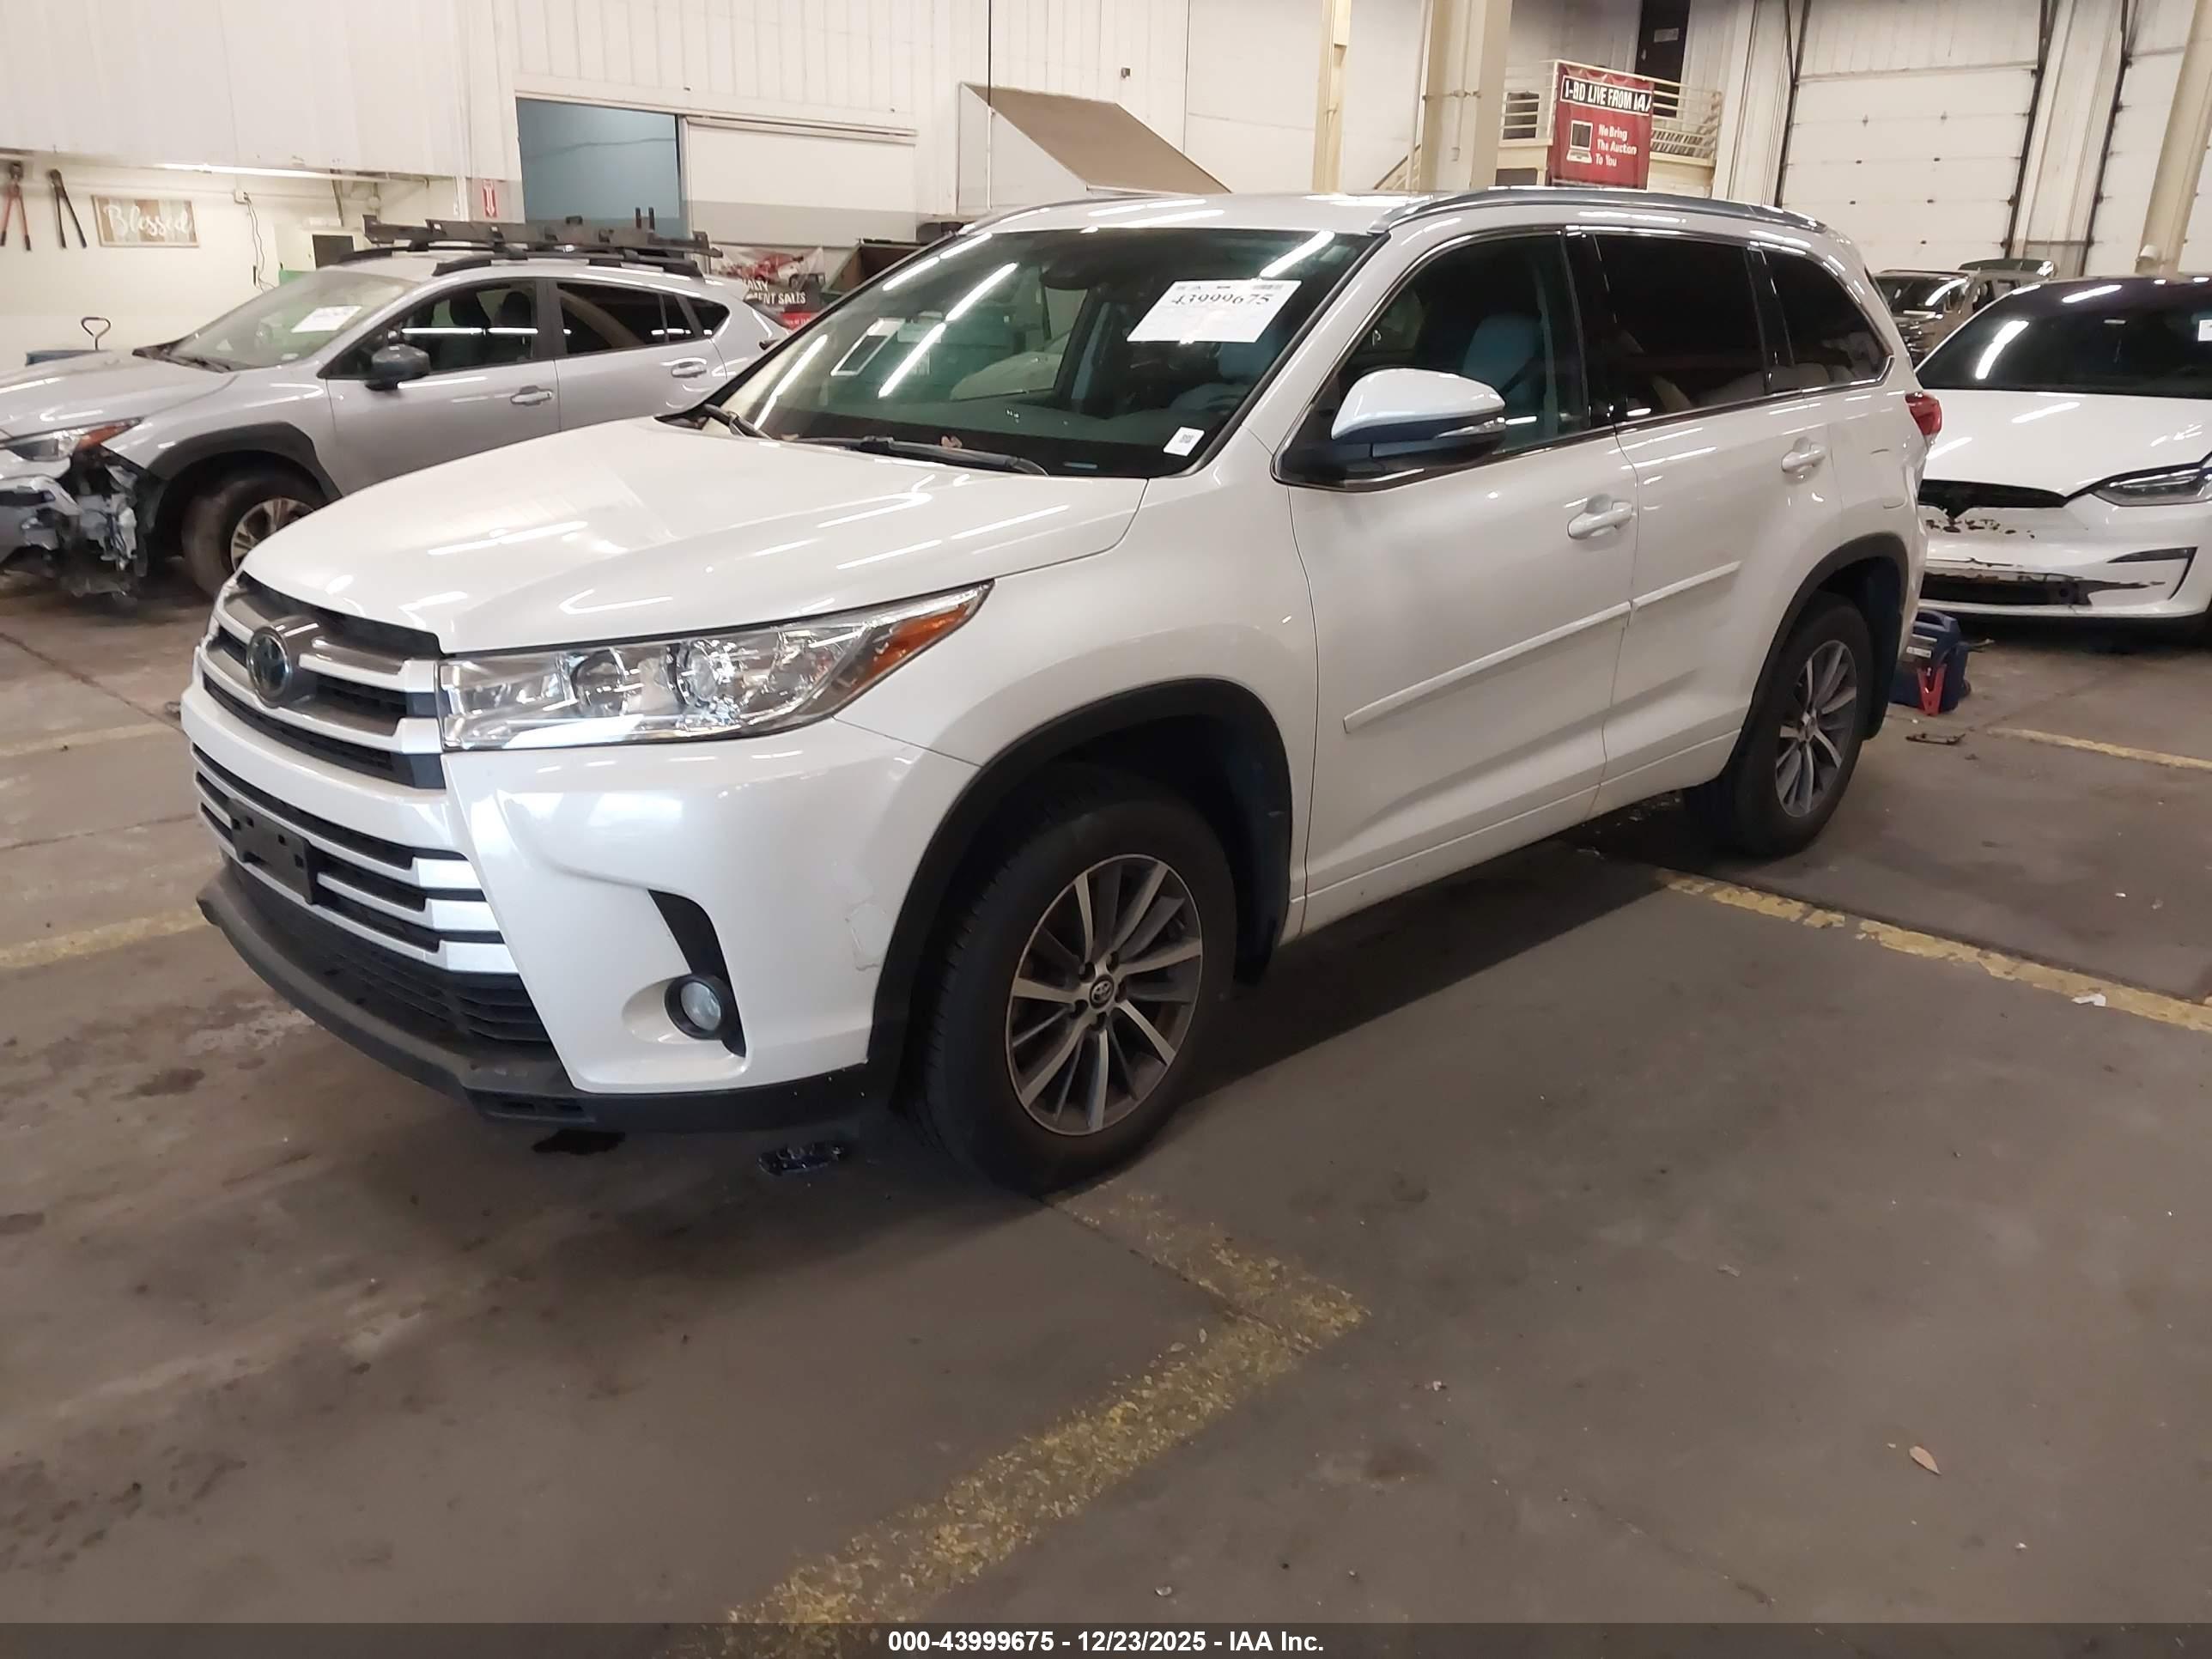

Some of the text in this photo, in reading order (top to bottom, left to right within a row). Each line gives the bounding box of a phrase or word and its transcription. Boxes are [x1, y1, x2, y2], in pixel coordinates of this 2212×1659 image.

[1587, 84, 1607, 104] LIVE
[1607, 88, 1632, 109] FROM
[1609, 125, 1628, 142] Bring
[1610, 141, 1637, 155] Auction
[1595, 153, 1617, 167] To You
[103, 205, 190, 237] Blessed
[778, 291, 805, 304] SALES
